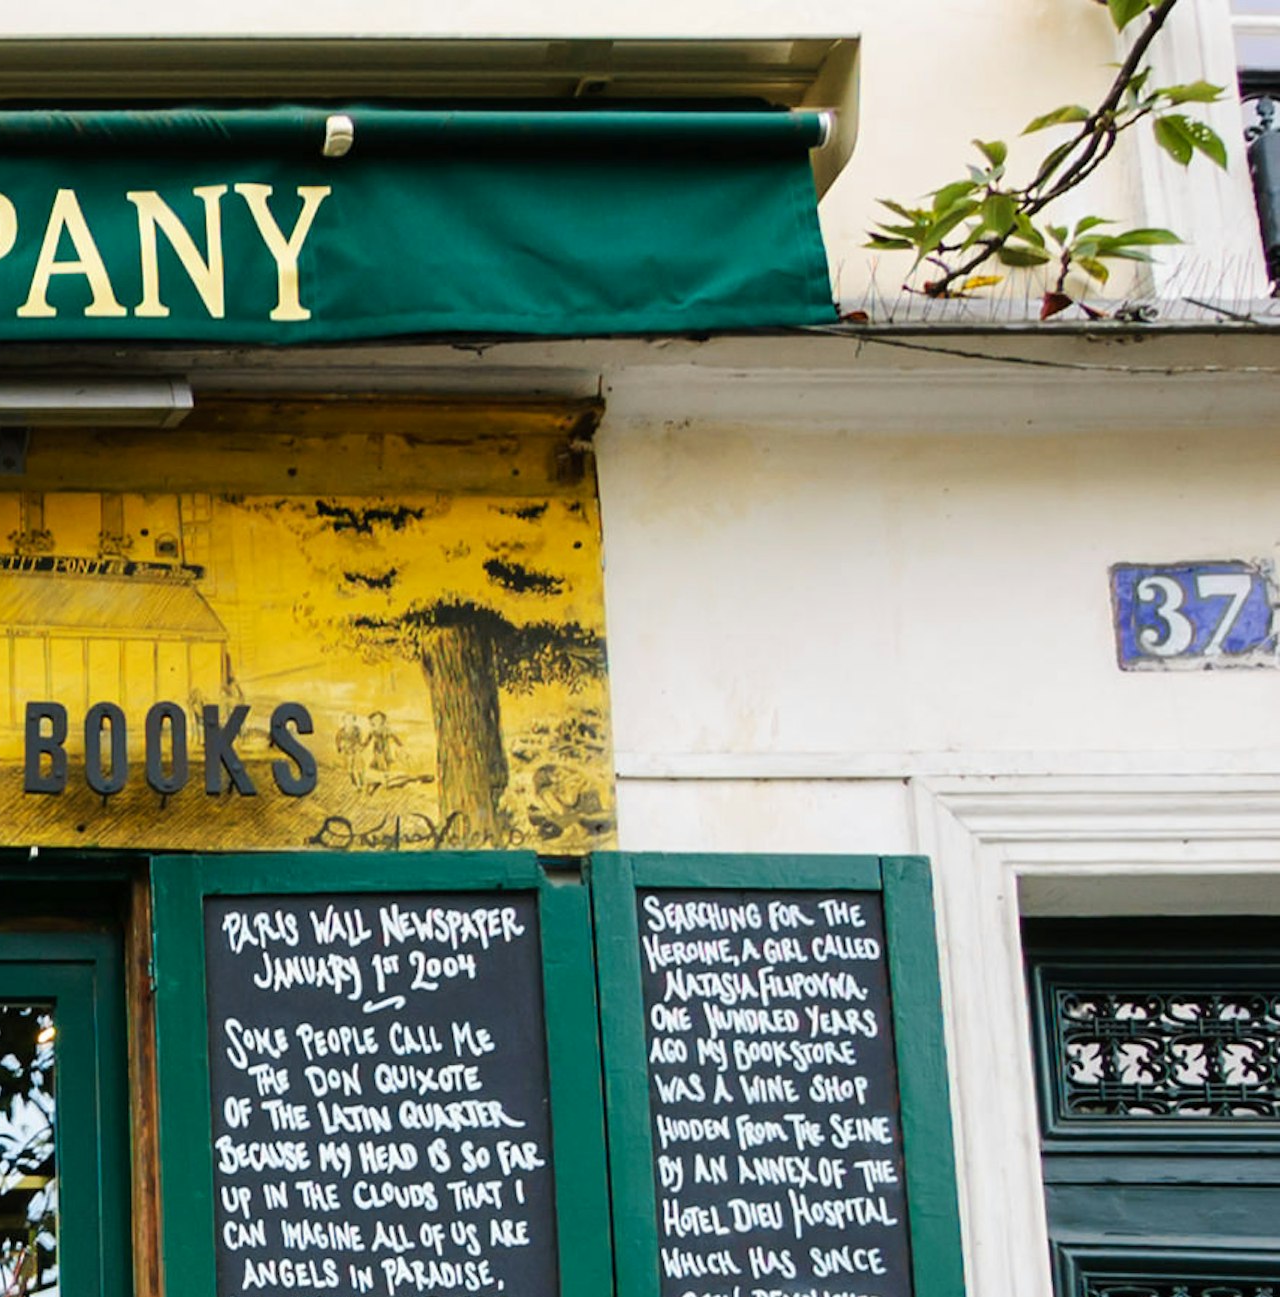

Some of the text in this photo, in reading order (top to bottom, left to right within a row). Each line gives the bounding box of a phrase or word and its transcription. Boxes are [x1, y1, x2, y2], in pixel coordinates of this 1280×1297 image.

[1137, 574, 1251, 656] 37
[23, 700, 319, 798] BOOKS
[222, 903, 525, 954] PARIS WALL NEWSPAPER
[643, 895, 866, 935] SEARCHING FOR THE
[253, 950, 476, 1001] JANUARY 1ST 2004
[642, 933, 880, 973] HEROINE, A GIRL CALLED
[663, 967, 868, 1006] NATASIA FILIPOVNA.
[650, 1001, 878, 1040] ONE HUNDRED YEARS
[224, 1018, 495, 1070] SOME PEOPLE CALL ME
[247, 1062, 483, 1097] THE DON QUIXOTE
